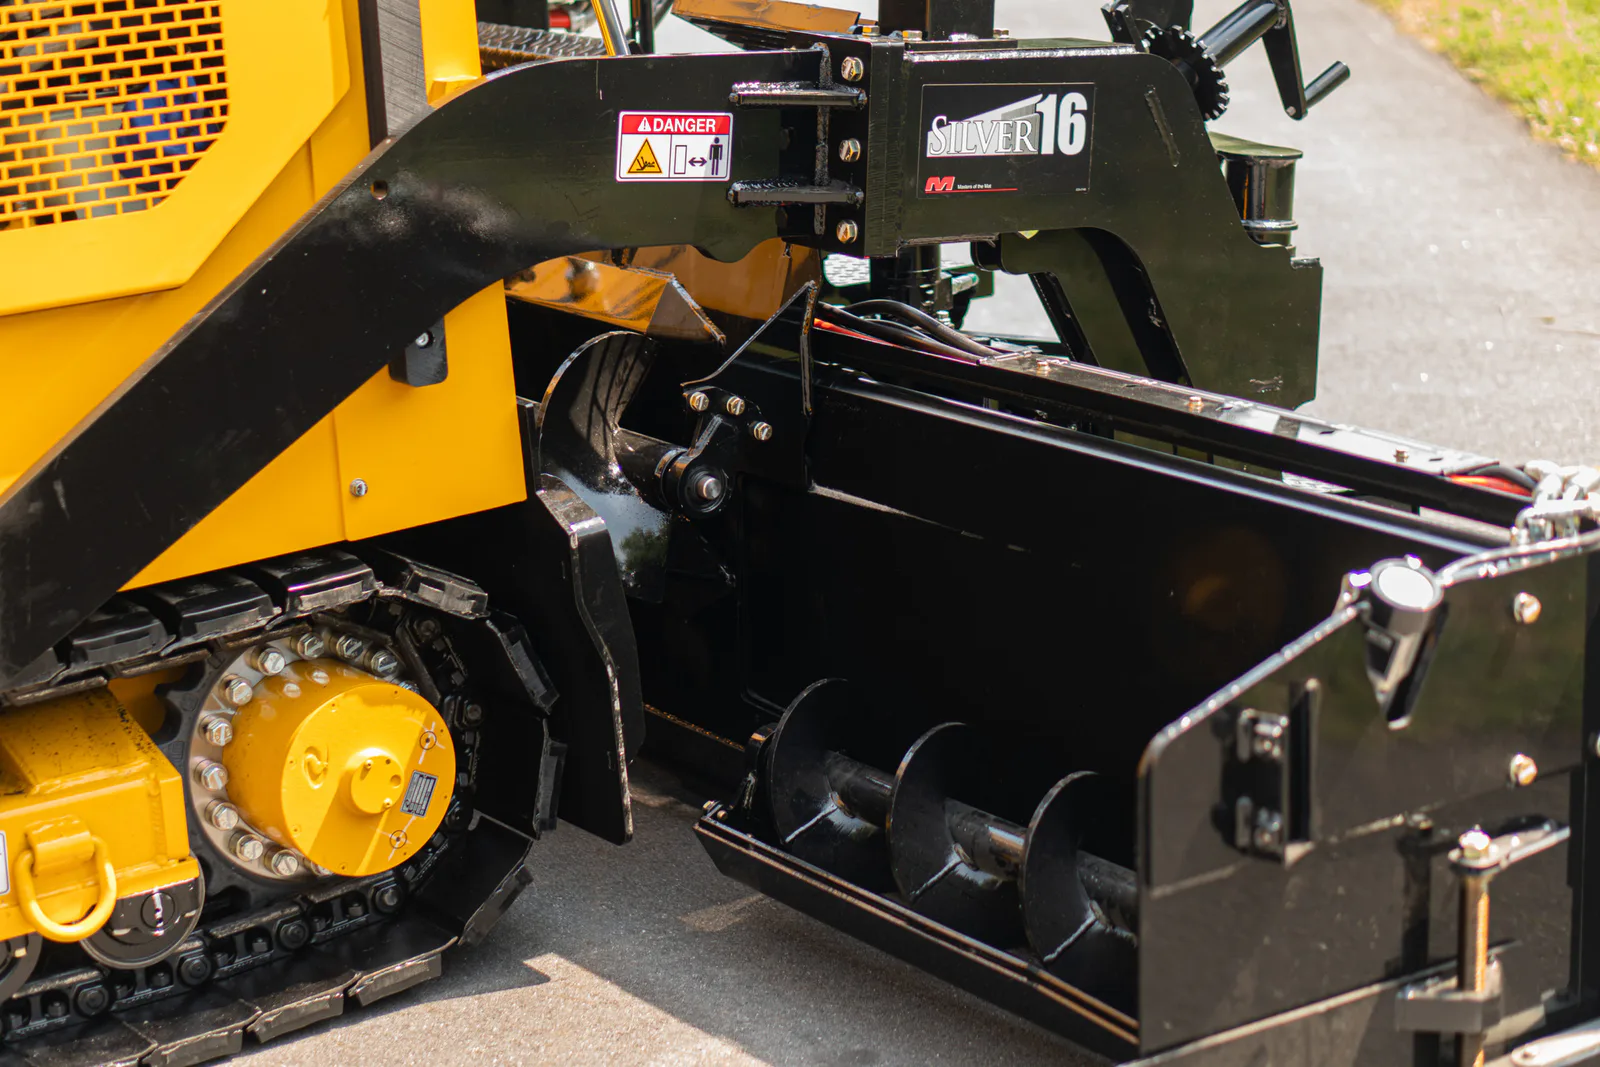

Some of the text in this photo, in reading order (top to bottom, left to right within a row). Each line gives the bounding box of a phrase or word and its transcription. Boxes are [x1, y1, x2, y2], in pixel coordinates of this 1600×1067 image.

[653, 118, 716, 133] DANGER
[929, 91, 1088, 156] SILVER 16
